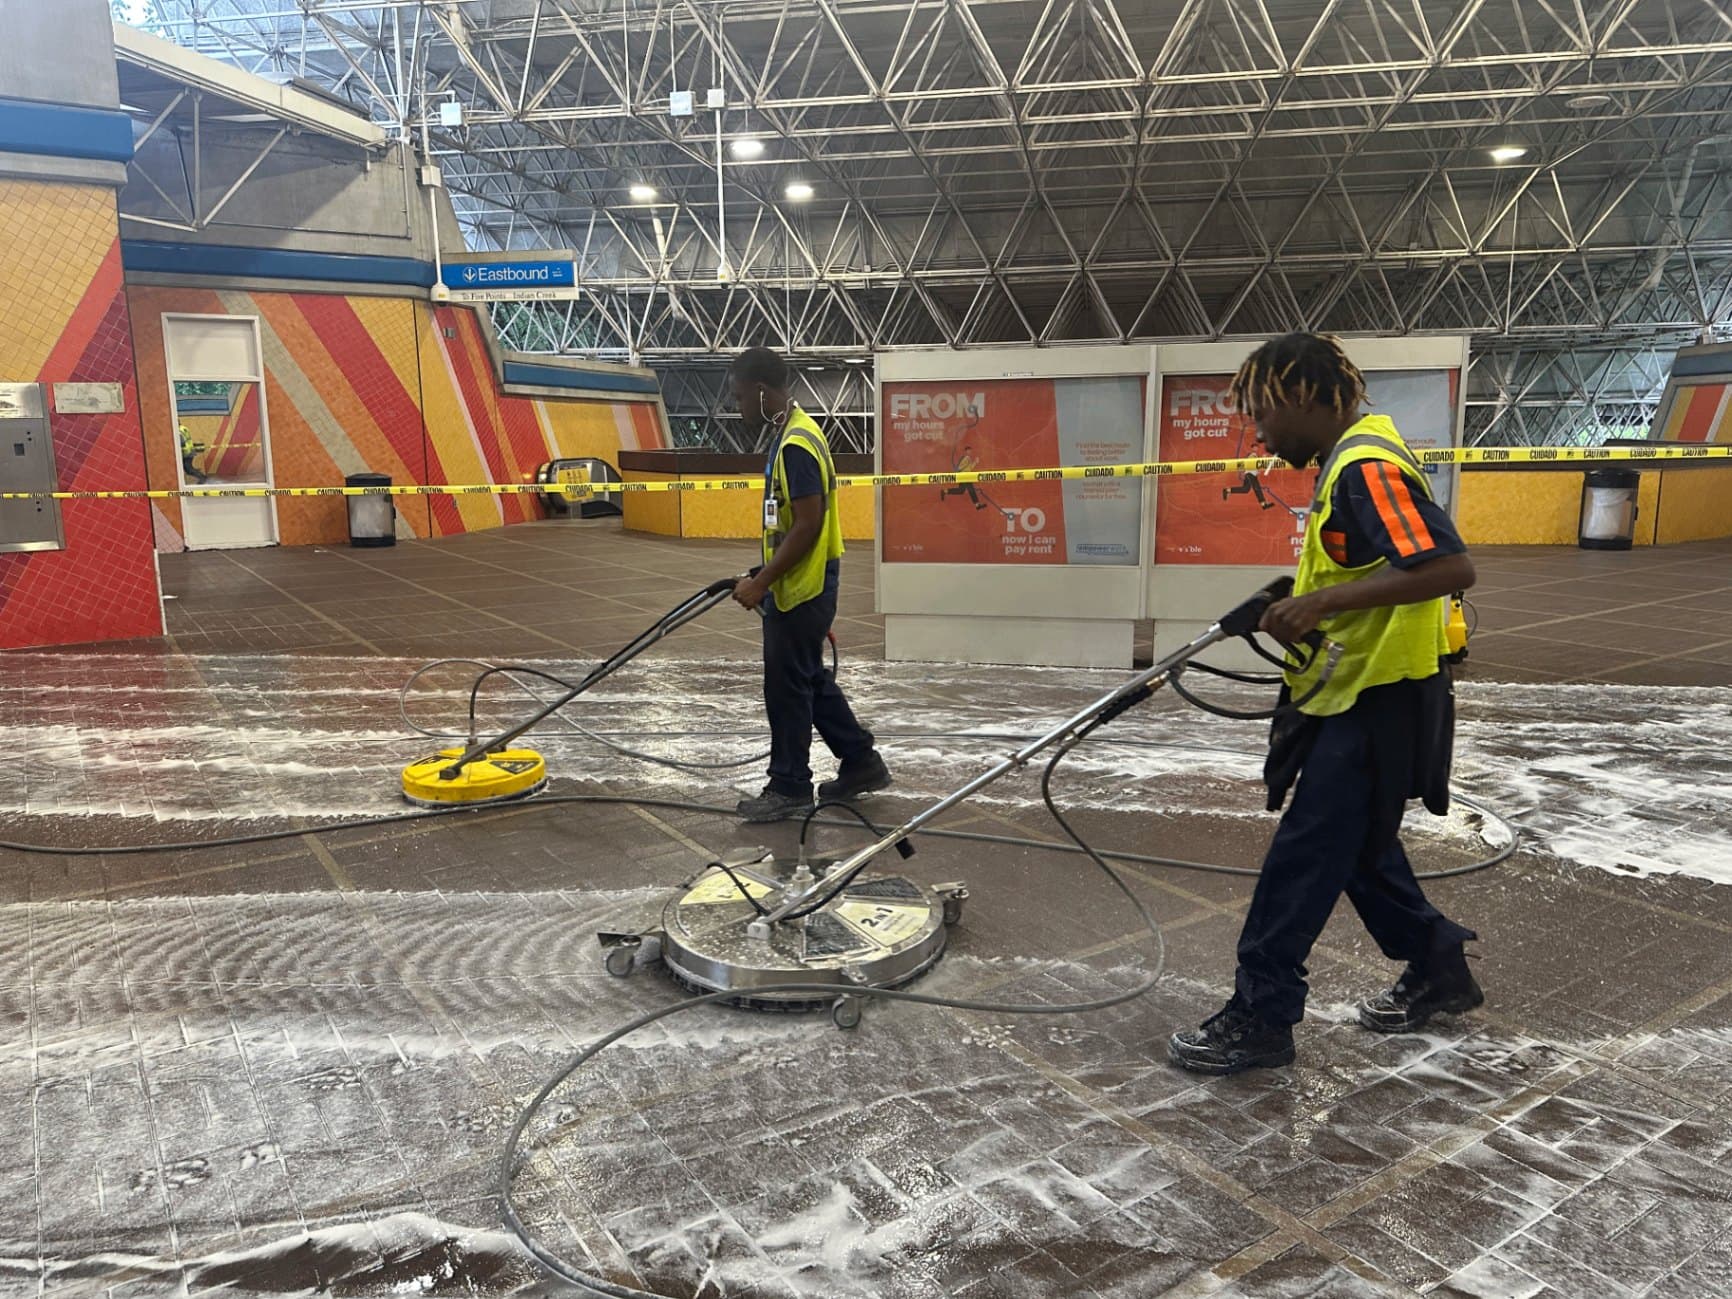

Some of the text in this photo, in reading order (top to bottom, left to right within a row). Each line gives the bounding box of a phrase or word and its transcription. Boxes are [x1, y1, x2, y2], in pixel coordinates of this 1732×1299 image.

[478, 266, 549, 281] Eastbound
[537, 291, 556, 299] Creek
[891, 392, 985, 419] FROM
[1171, 389, 1248, 416] FRO
[893, 419, 945, 432] my hours
[1173, 417, 1230, 429] my hours
[904, 430, 945, 442] got cut
[1184, 428, 1228, 440] got cut
[517, 485, 545, 493] CAUTION
[721, 481, 750, 489] CAUTION
[872, 477, 901, 485] CUIDADO
[928, 474, 957, 483] CAUTION
[977, 472, 1006, 481] CUIDADO
[1034, 471, 1063, 479] CAUTION
[1084, 468, 1114, 477] CUIDADO
[1143, 465, 1173, 474] CAUTION
[1195, 462, 1226, 472] CUIDADO
[1423, 451, 1455, 462] CUIDADO
[1482, 450, 1510, 460] CAUTION
[1529, 449, 1558, 460] CUIDADO
[1583, 450, 1611, 458] CAUTION
[1629, 449, 1657, 458] CUIDADO
[1682, 448, 1709, 456] CAUTION
[1002, 507, 1046, 532] TO
[1002, 536, 1025, 544] now
[1035, 536, 1056, 544] can
[1005, 544, 1052, 556] pay rent
[861, 918, 880, 928] 2
